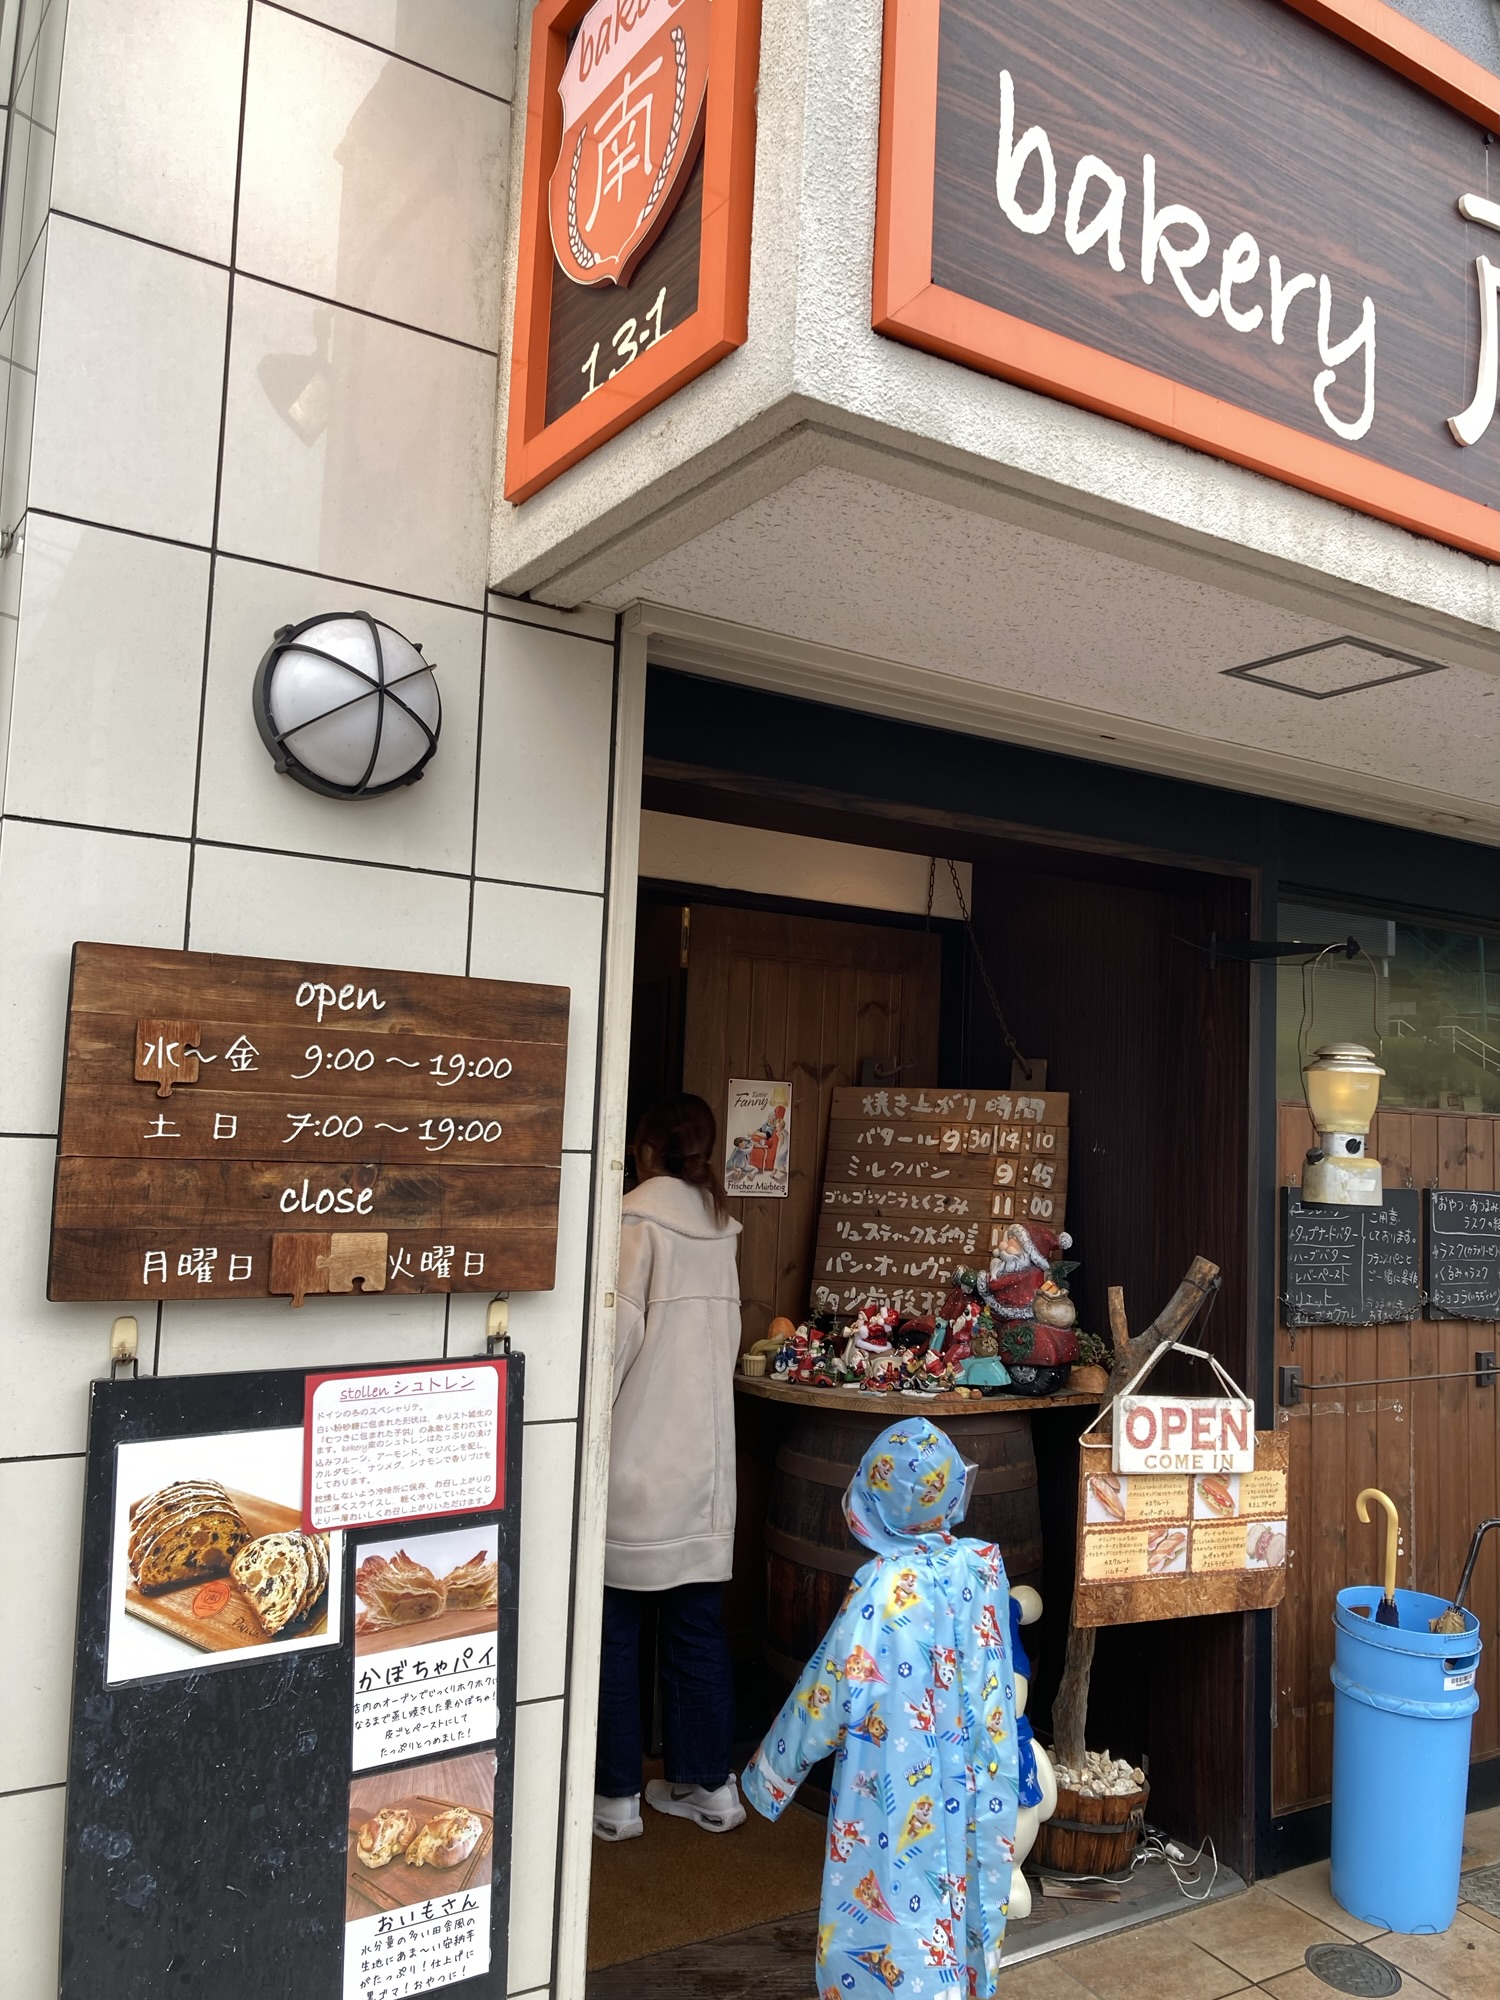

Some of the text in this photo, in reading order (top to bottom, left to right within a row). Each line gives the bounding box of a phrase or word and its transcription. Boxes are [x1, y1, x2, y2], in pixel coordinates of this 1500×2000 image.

[584, 56, 664, 232] 南
[996, 69, 1376, 441] bakery
[296, 981, 387, 1023] open
[734, 1092, 769, 1111] Fanny
[857, 1126, 940, 1147] バタール
[279, 1180, 374, 1214] close
[727, 1180, 753, 1190] Frischer
[993, 1196, 1053, 1217] 11:00
[143, 1246, 485, 1284] 月曜日 火曜日
[1296, 1265, 1350, 1283] レバーペースト
[340, 1375, 475, 1400] stollen シュトレン
[1125, 1406, 1248, 1450] OPEN
[1144, 1454, 1234, 1470] COME IN
[359, 1647, 494, 1691] かぼちゃパイ
[378, 1894, 477, 1932] おいもさん
